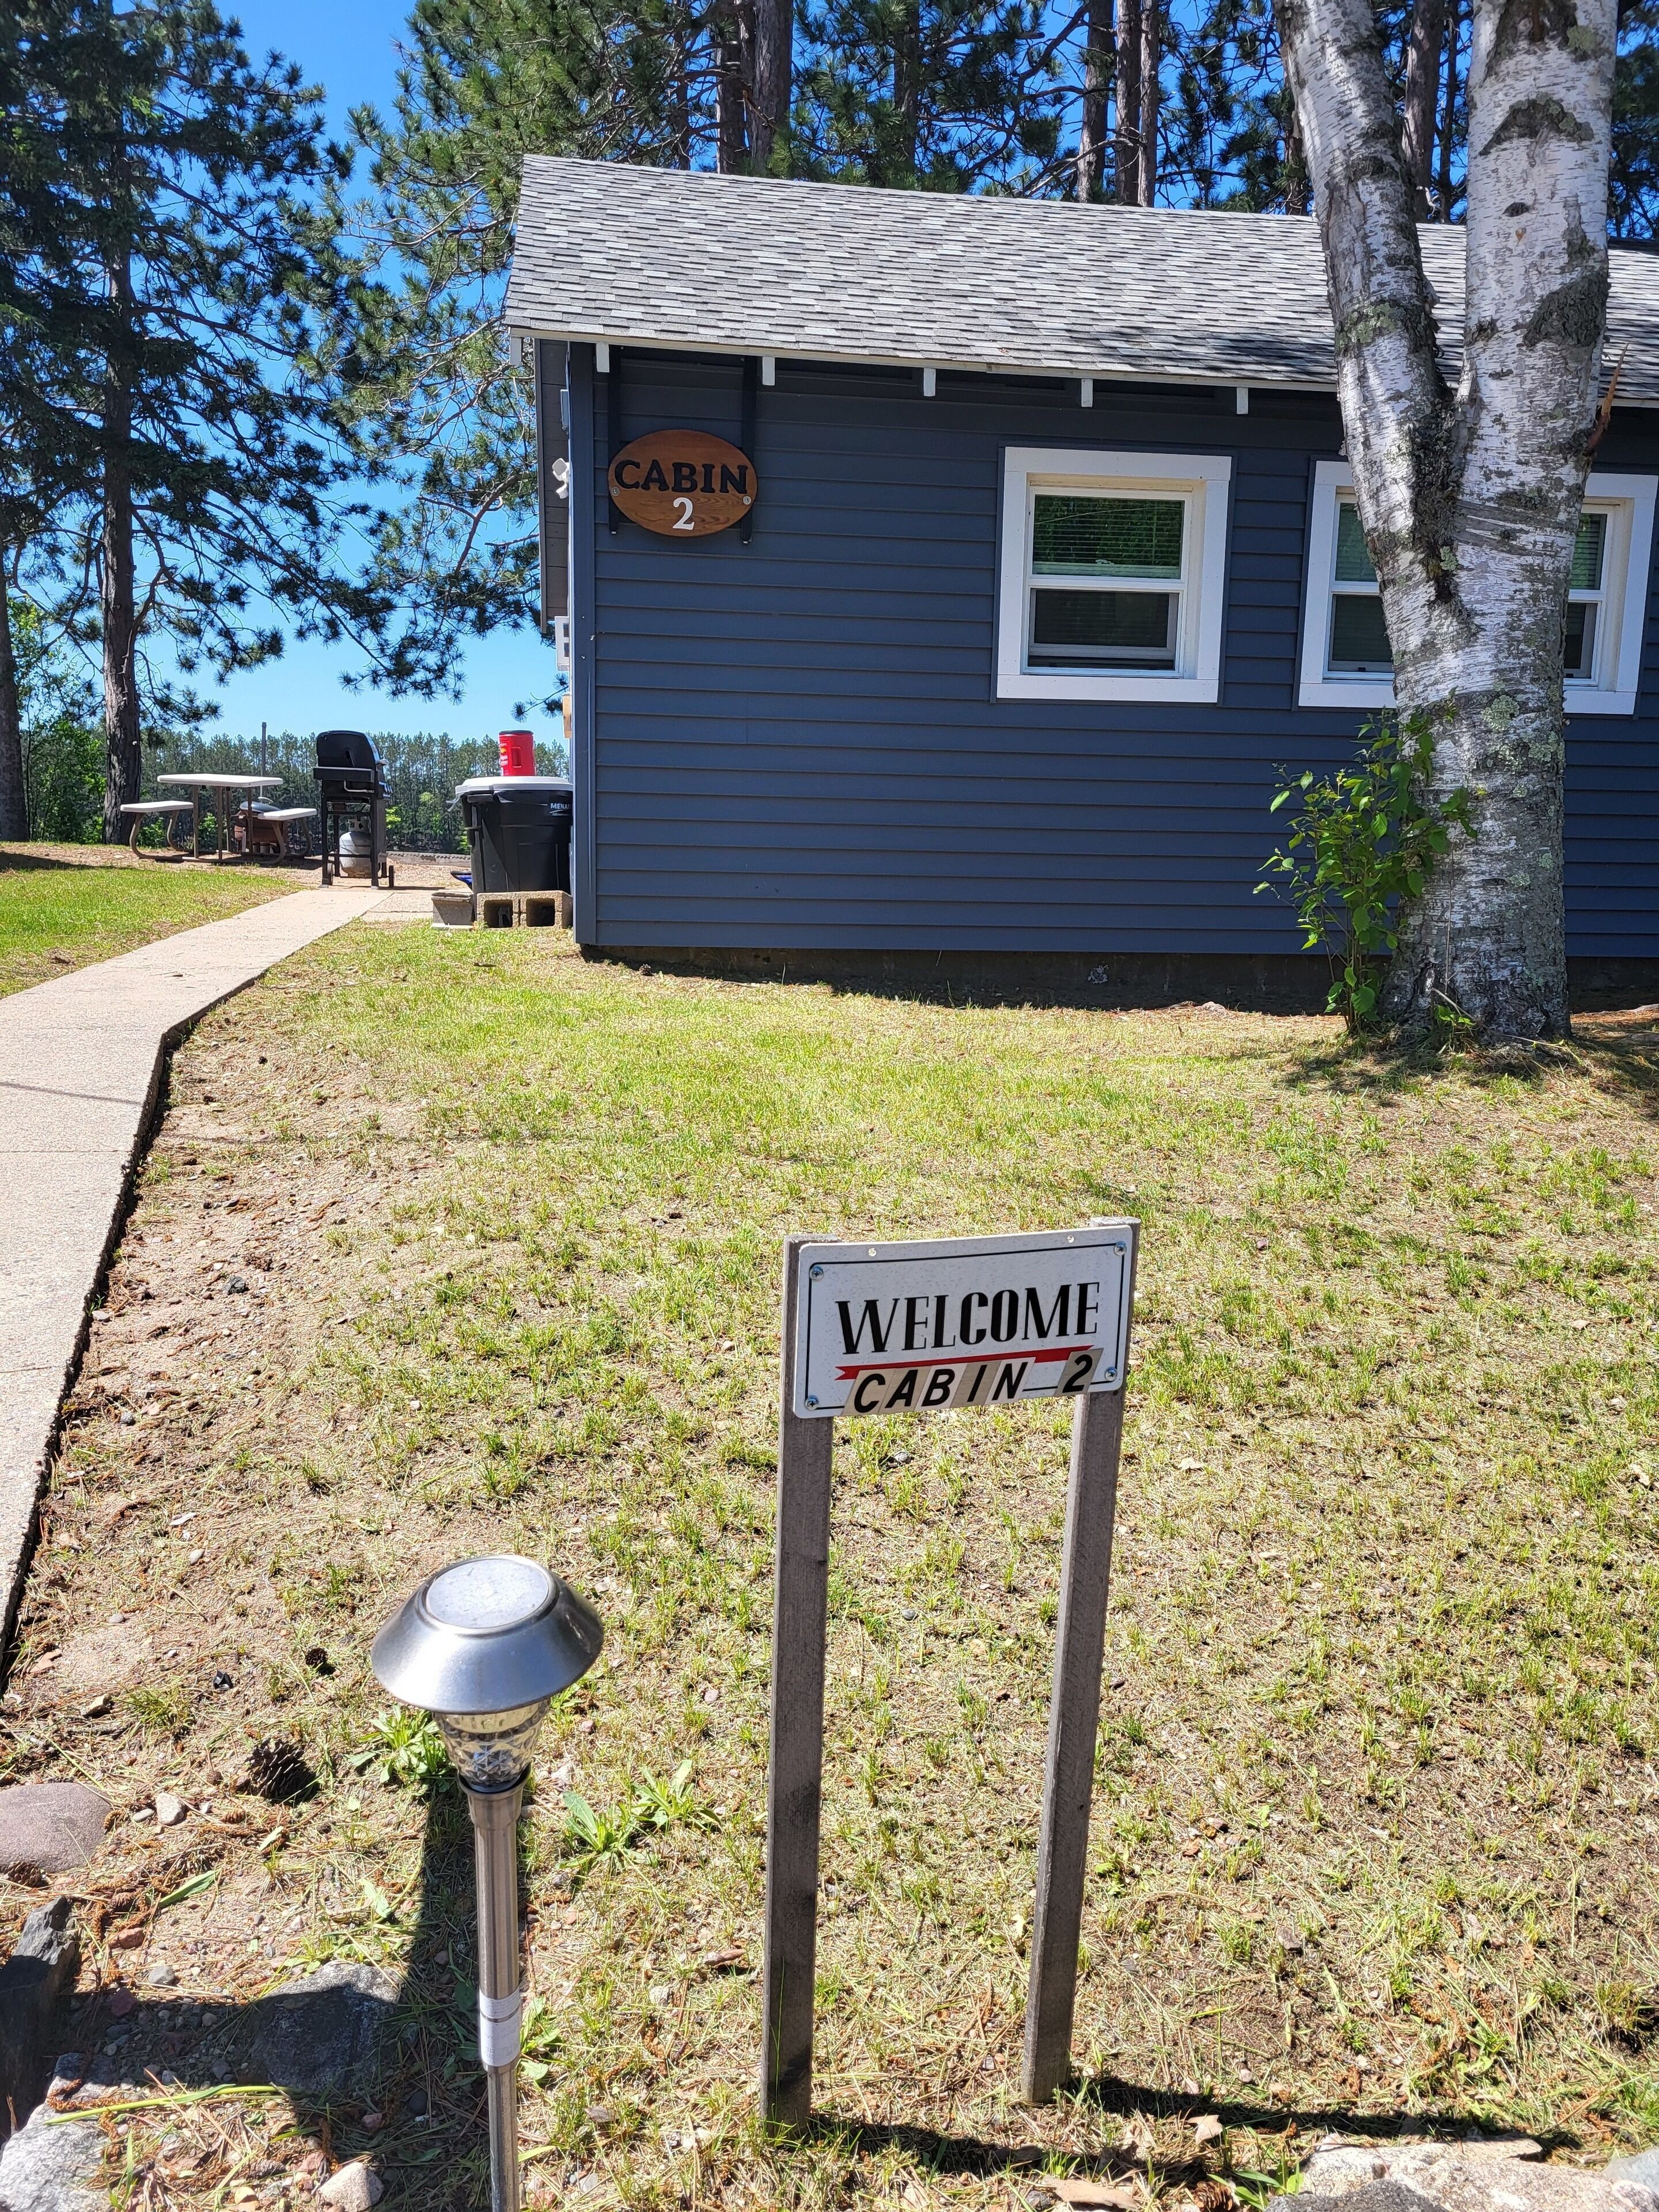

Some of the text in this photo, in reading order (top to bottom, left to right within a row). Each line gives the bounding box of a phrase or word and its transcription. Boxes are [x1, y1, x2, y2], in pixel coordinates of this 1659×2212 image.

[615, 460, 748, 494] CABIN
[672, 497, 695, 530] 2
[835, 1282, 1100, 1354] WELCOME
[854, 1354, 1093, 1413] CABIN 2
